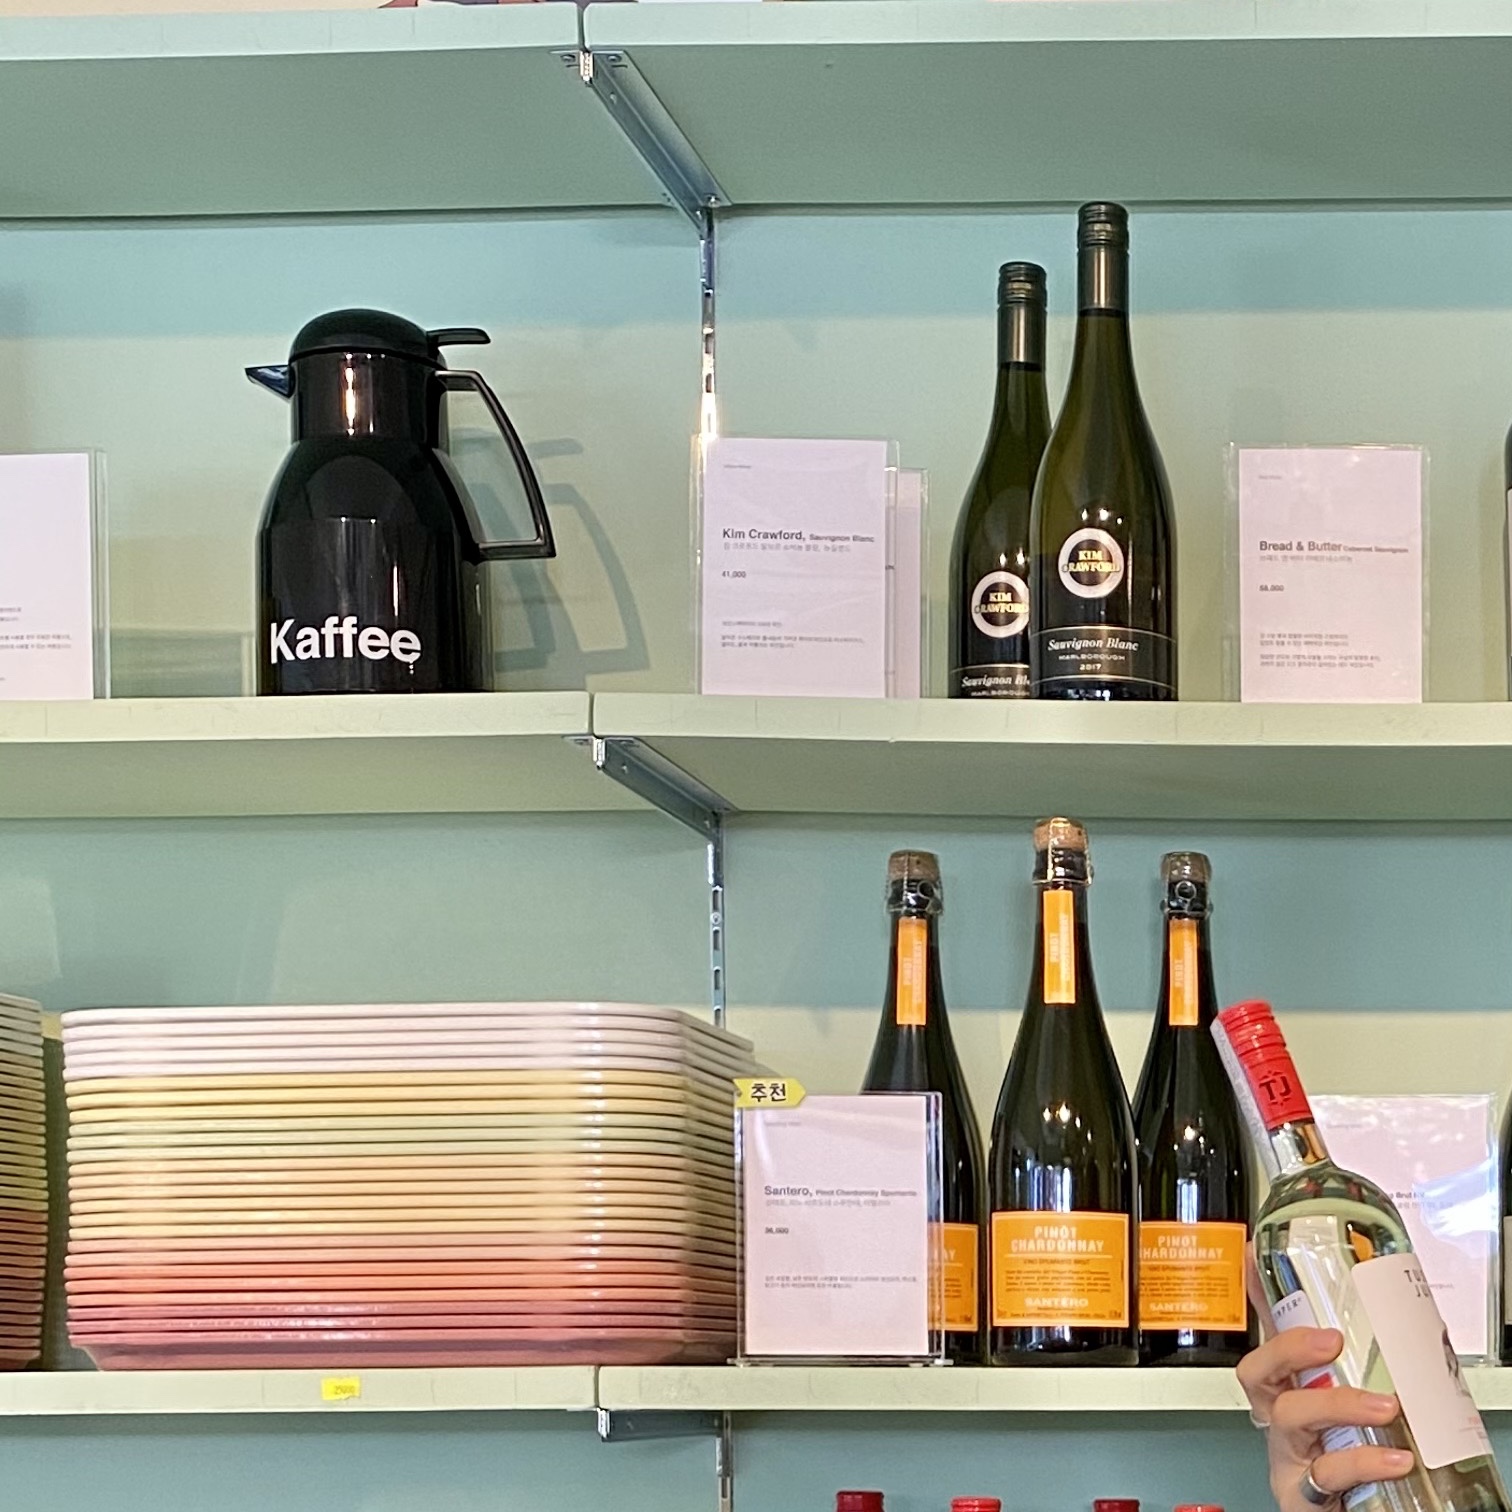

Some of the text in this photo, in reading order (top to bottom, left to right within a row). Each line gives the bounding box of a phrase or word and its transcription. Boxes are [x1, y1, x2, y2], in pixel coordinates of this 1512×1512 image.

[722, 528, 745, 540] Kim
[748, 528, 806, 542] Crawford,
[1259, 540, 1293, 552] Bread
[1296, 540, 1304, 552] &
[1308, 541, 1342, 552] Butter
[1078, 550, 1103, 561] KIM
[989, 591, 1012, 602] KIM
[270, 614, 422, 664] Kaffee
[1047, 637, 1140, 652] Sauvignon Blanc
[961, 673, 1013, 688] Sauvignon
[751, 1082, 787, 1102] 추천
[1258, 1074, 1291, 1101] TJ
[764, 1185, 813, 1197] Santero,
[1034, 1225, 1077, 1239] PINOT
[1011, 1239, 1104, 1253] CHARDONNAY
[1157, 1235, 1198, 1247] PINOT
